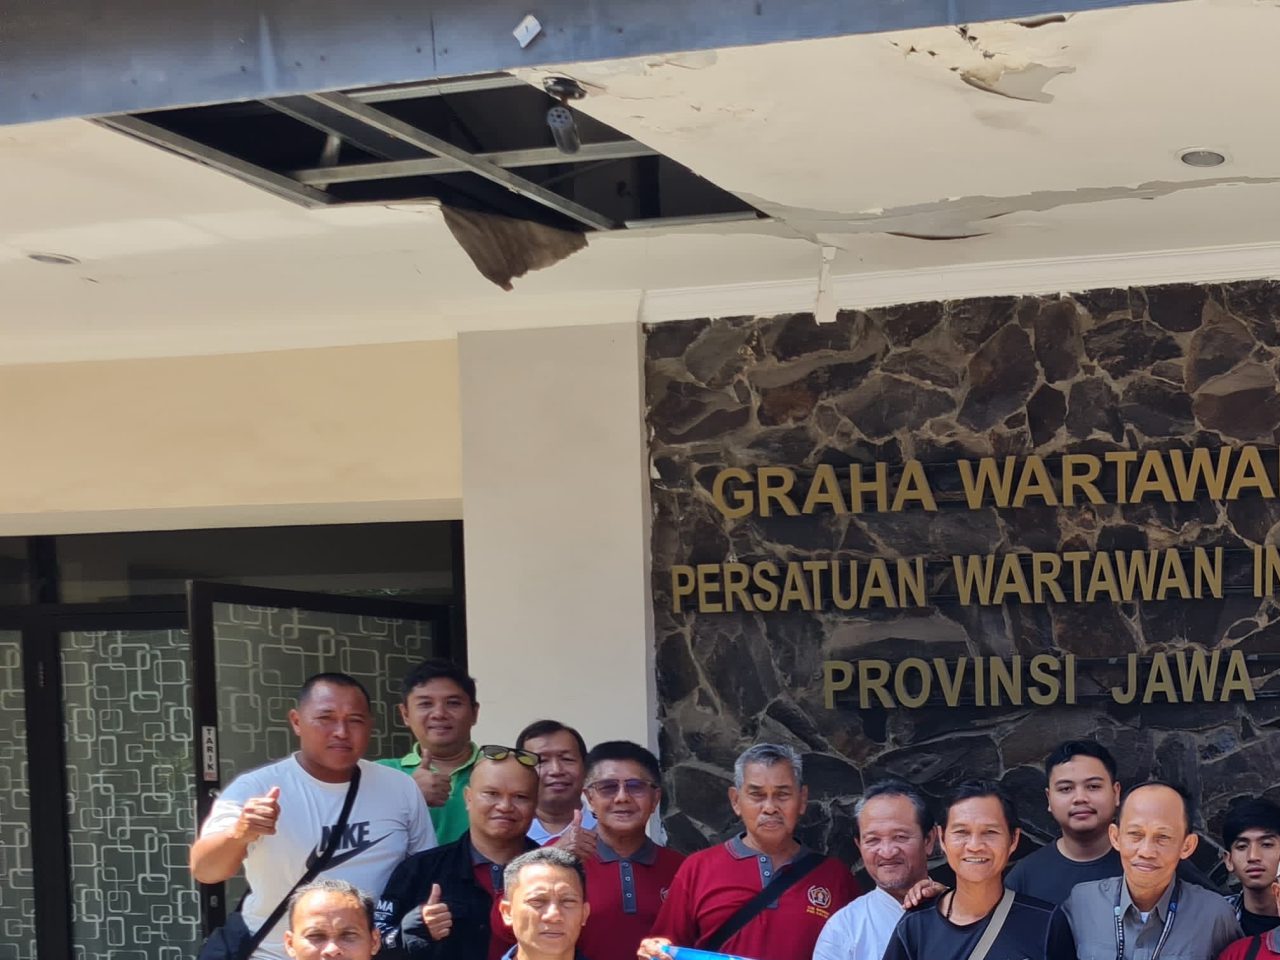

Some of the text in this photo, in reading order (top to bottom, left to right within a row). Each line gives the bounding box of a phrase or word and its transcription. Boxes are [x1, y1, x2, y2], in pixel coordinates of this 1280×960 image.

[713, 459, 937, 519] GRAHA
[672, 557, 926, 614] PERSATUAN
[953, 545, 1223, 606] WARTAWAN
[823, 653, 1076, 709] PROVINSI
[1111, 649, 1256, 704] JAWA
[206, 727, 215, 771] TARIK
[319, 821, 370, 852] NKE
